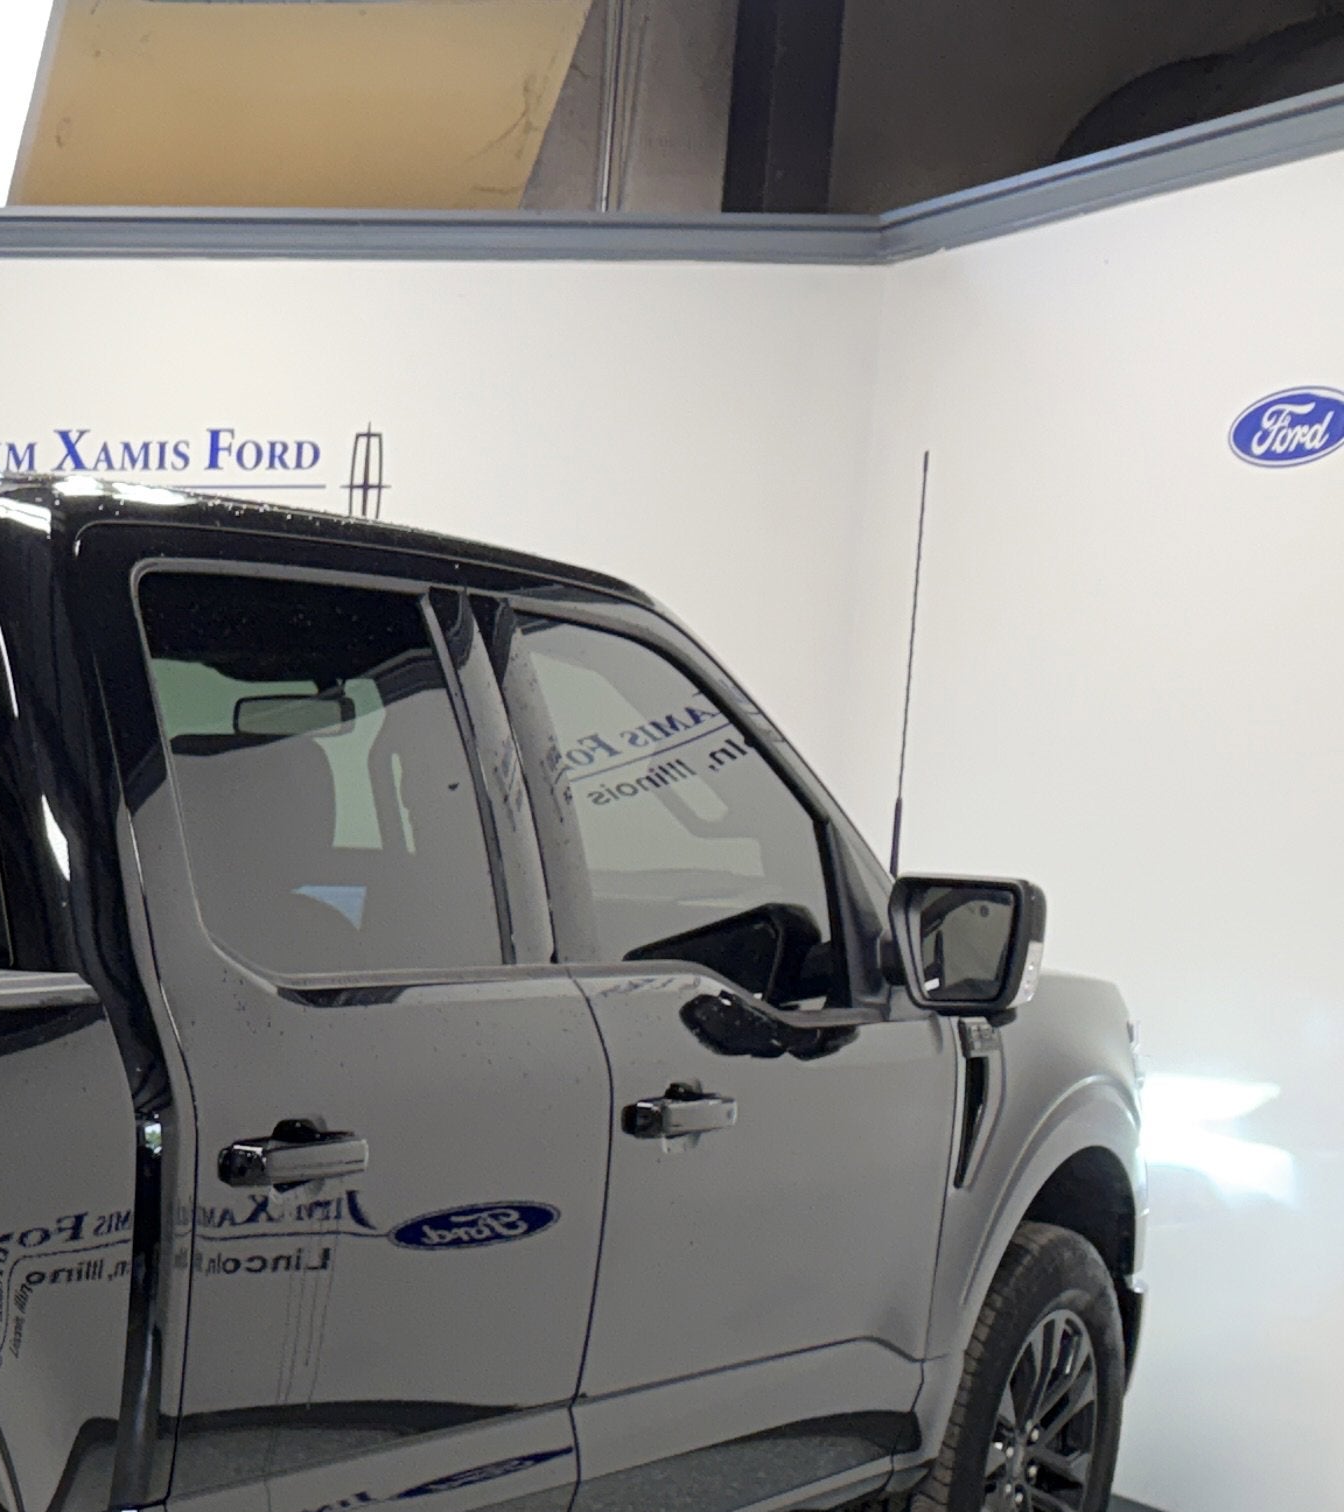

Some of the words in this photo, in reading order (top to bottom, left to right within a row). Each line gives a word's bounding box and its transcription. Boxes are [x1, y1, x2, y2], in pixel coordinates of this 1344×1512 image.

[49, 427, 192, 472] XAMIS
[204, 427, 321, 471] FORD
[1250, 401, 1335, 456] Ford
